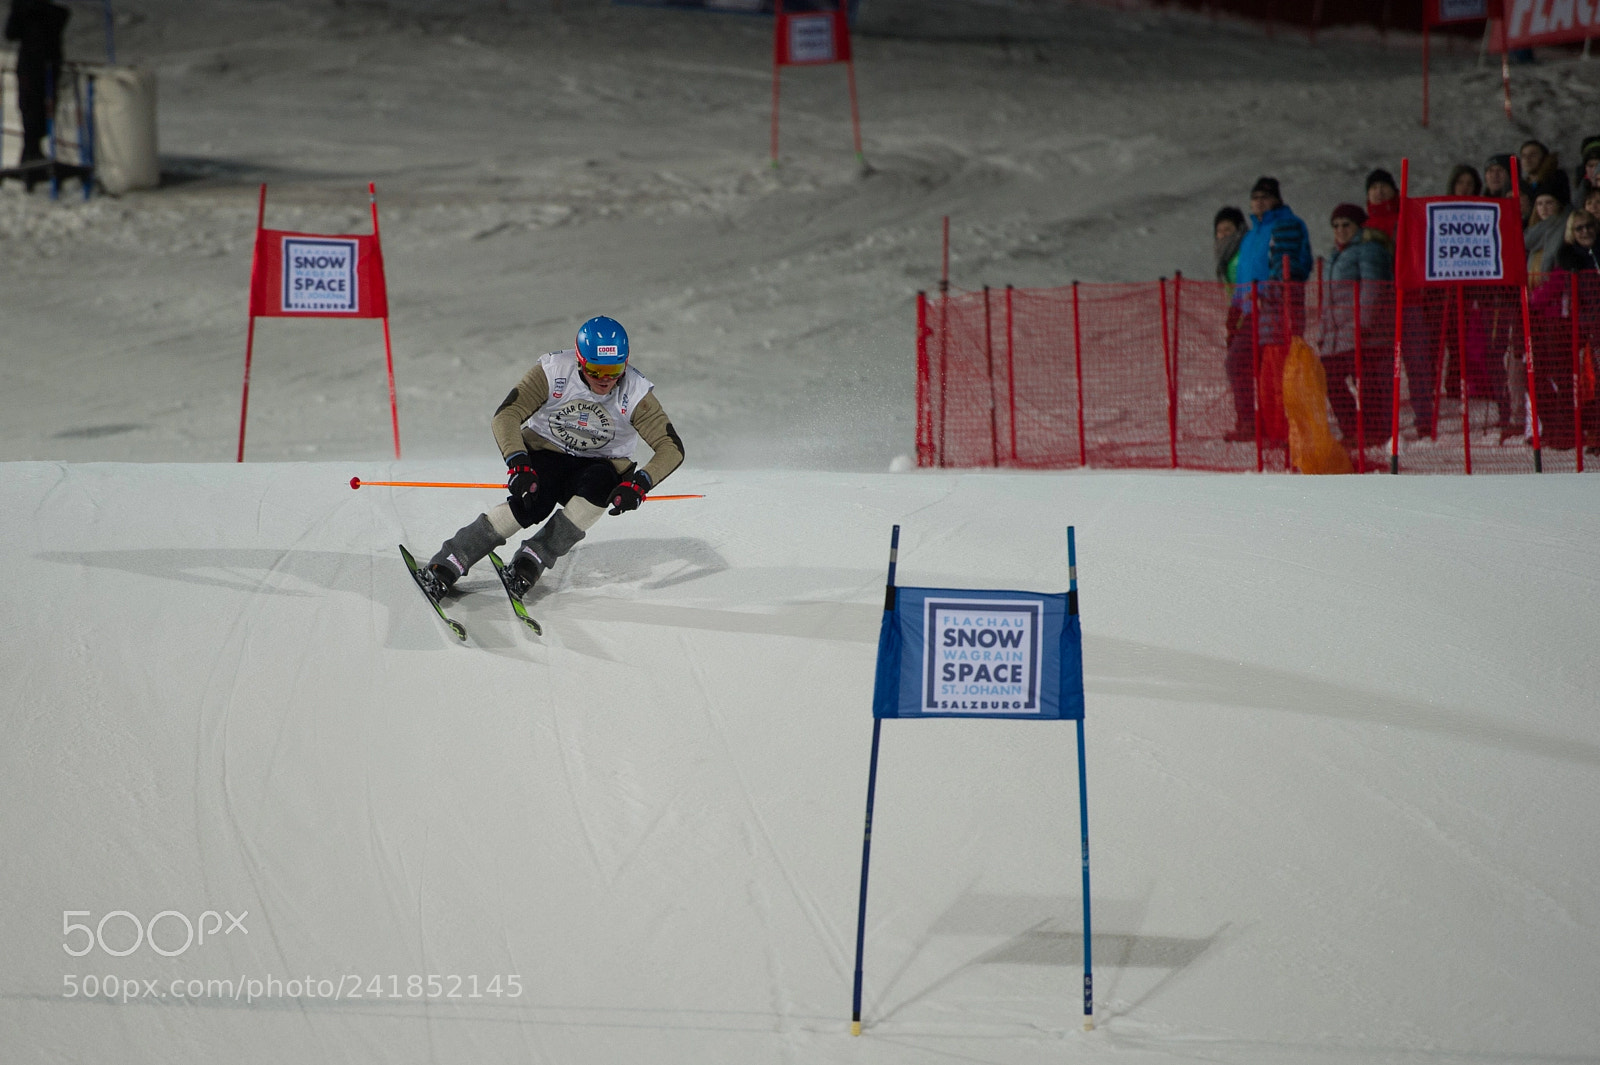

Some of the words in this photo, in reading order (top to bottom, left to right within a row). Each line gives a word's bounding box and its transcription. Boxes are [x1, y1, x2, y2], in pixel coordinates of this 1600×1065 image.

[1439, 222, 1490, 236] SNOW
[1439, 246, 1491, 258] SPACE
[294, 256, 346, 269] SNOW
[294, 278, 346, 292] SPACE
[558, 405, 576, 416] STAR
[577, 402, 610, 428] CHALLENGE
[943, 616, 1024, 628] FLACHAU
[942, 628, 1025, 649] SNOW
[943, 650, 1024, 662] WAGRAIN
[942, 662, 1023, 684] SPACE
[941, 684, 960, 695] ST.
[962, 684, 1022, 696] JOHANN
[941, 700, 1023, 709] SALZBURG
